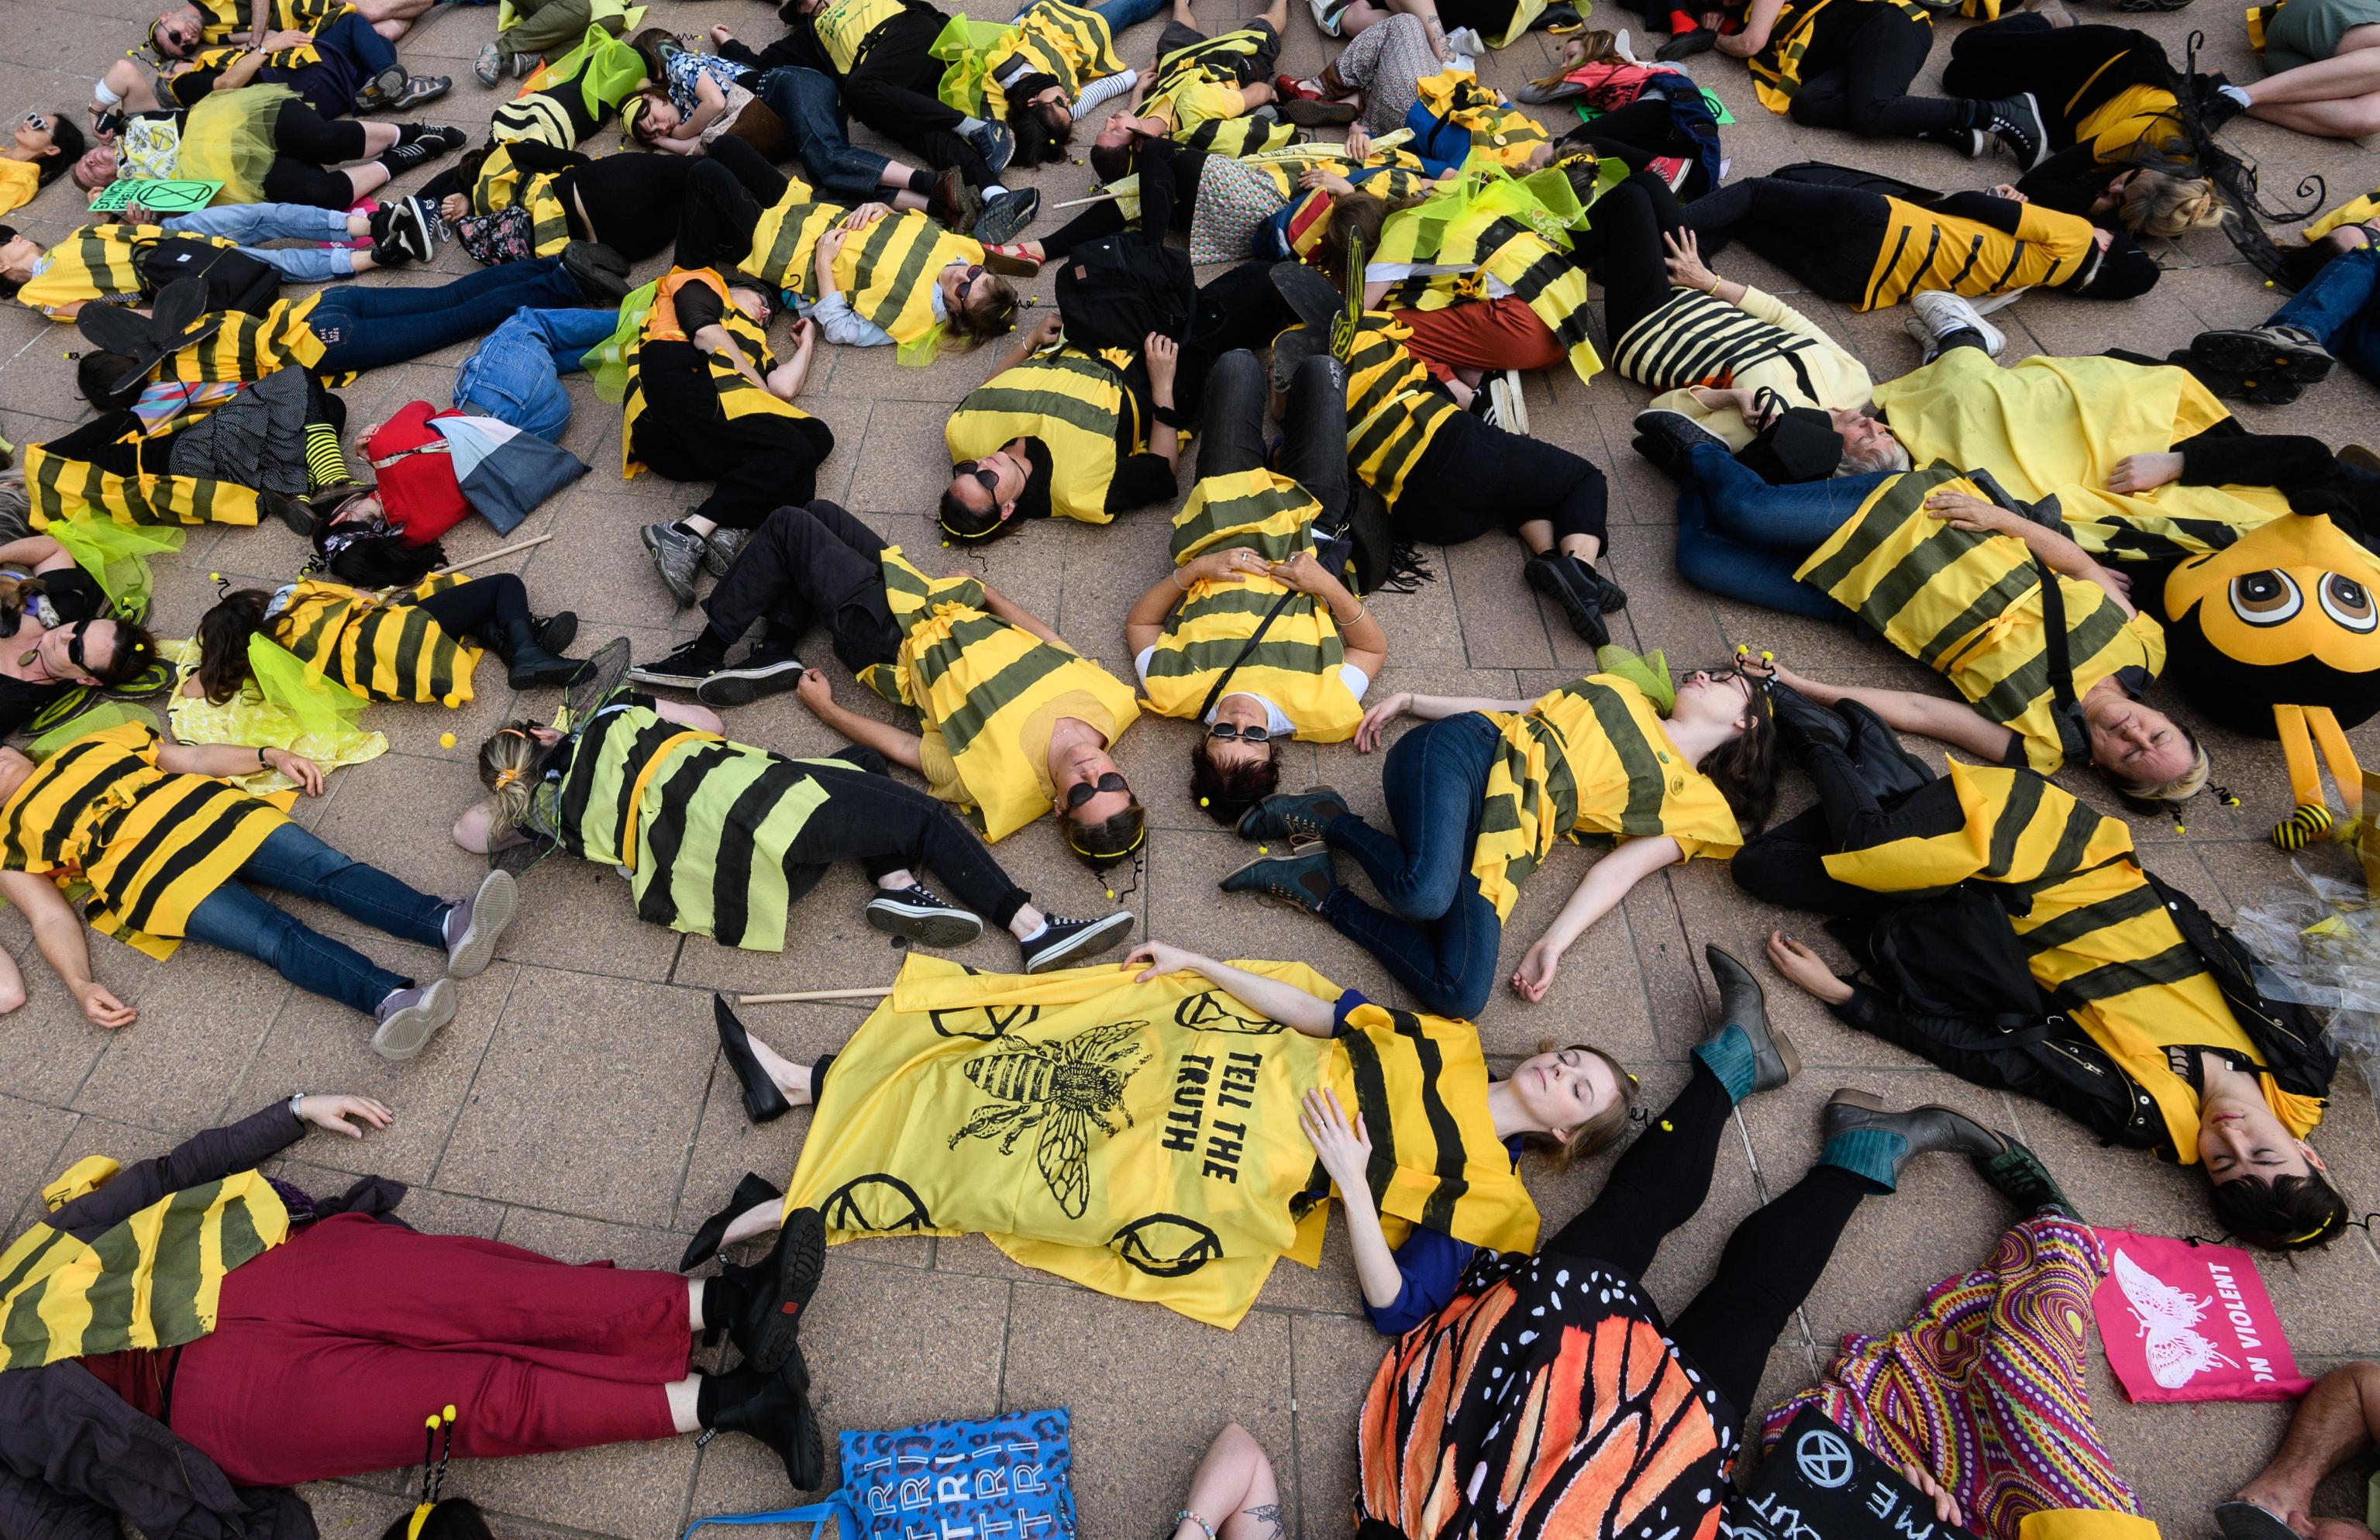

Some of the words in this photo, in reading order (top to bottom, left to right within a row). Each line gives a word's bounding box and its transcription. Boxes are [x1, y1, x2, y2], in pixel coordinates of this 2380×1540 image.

[1161, 1054, 1215, 1152] TRUTH
[1218, 1052, 1263, 1109] TELL
[1201, 1119, 1247, 1184] THE
[2207, 1262, 2262, 1349] VIOLENT
